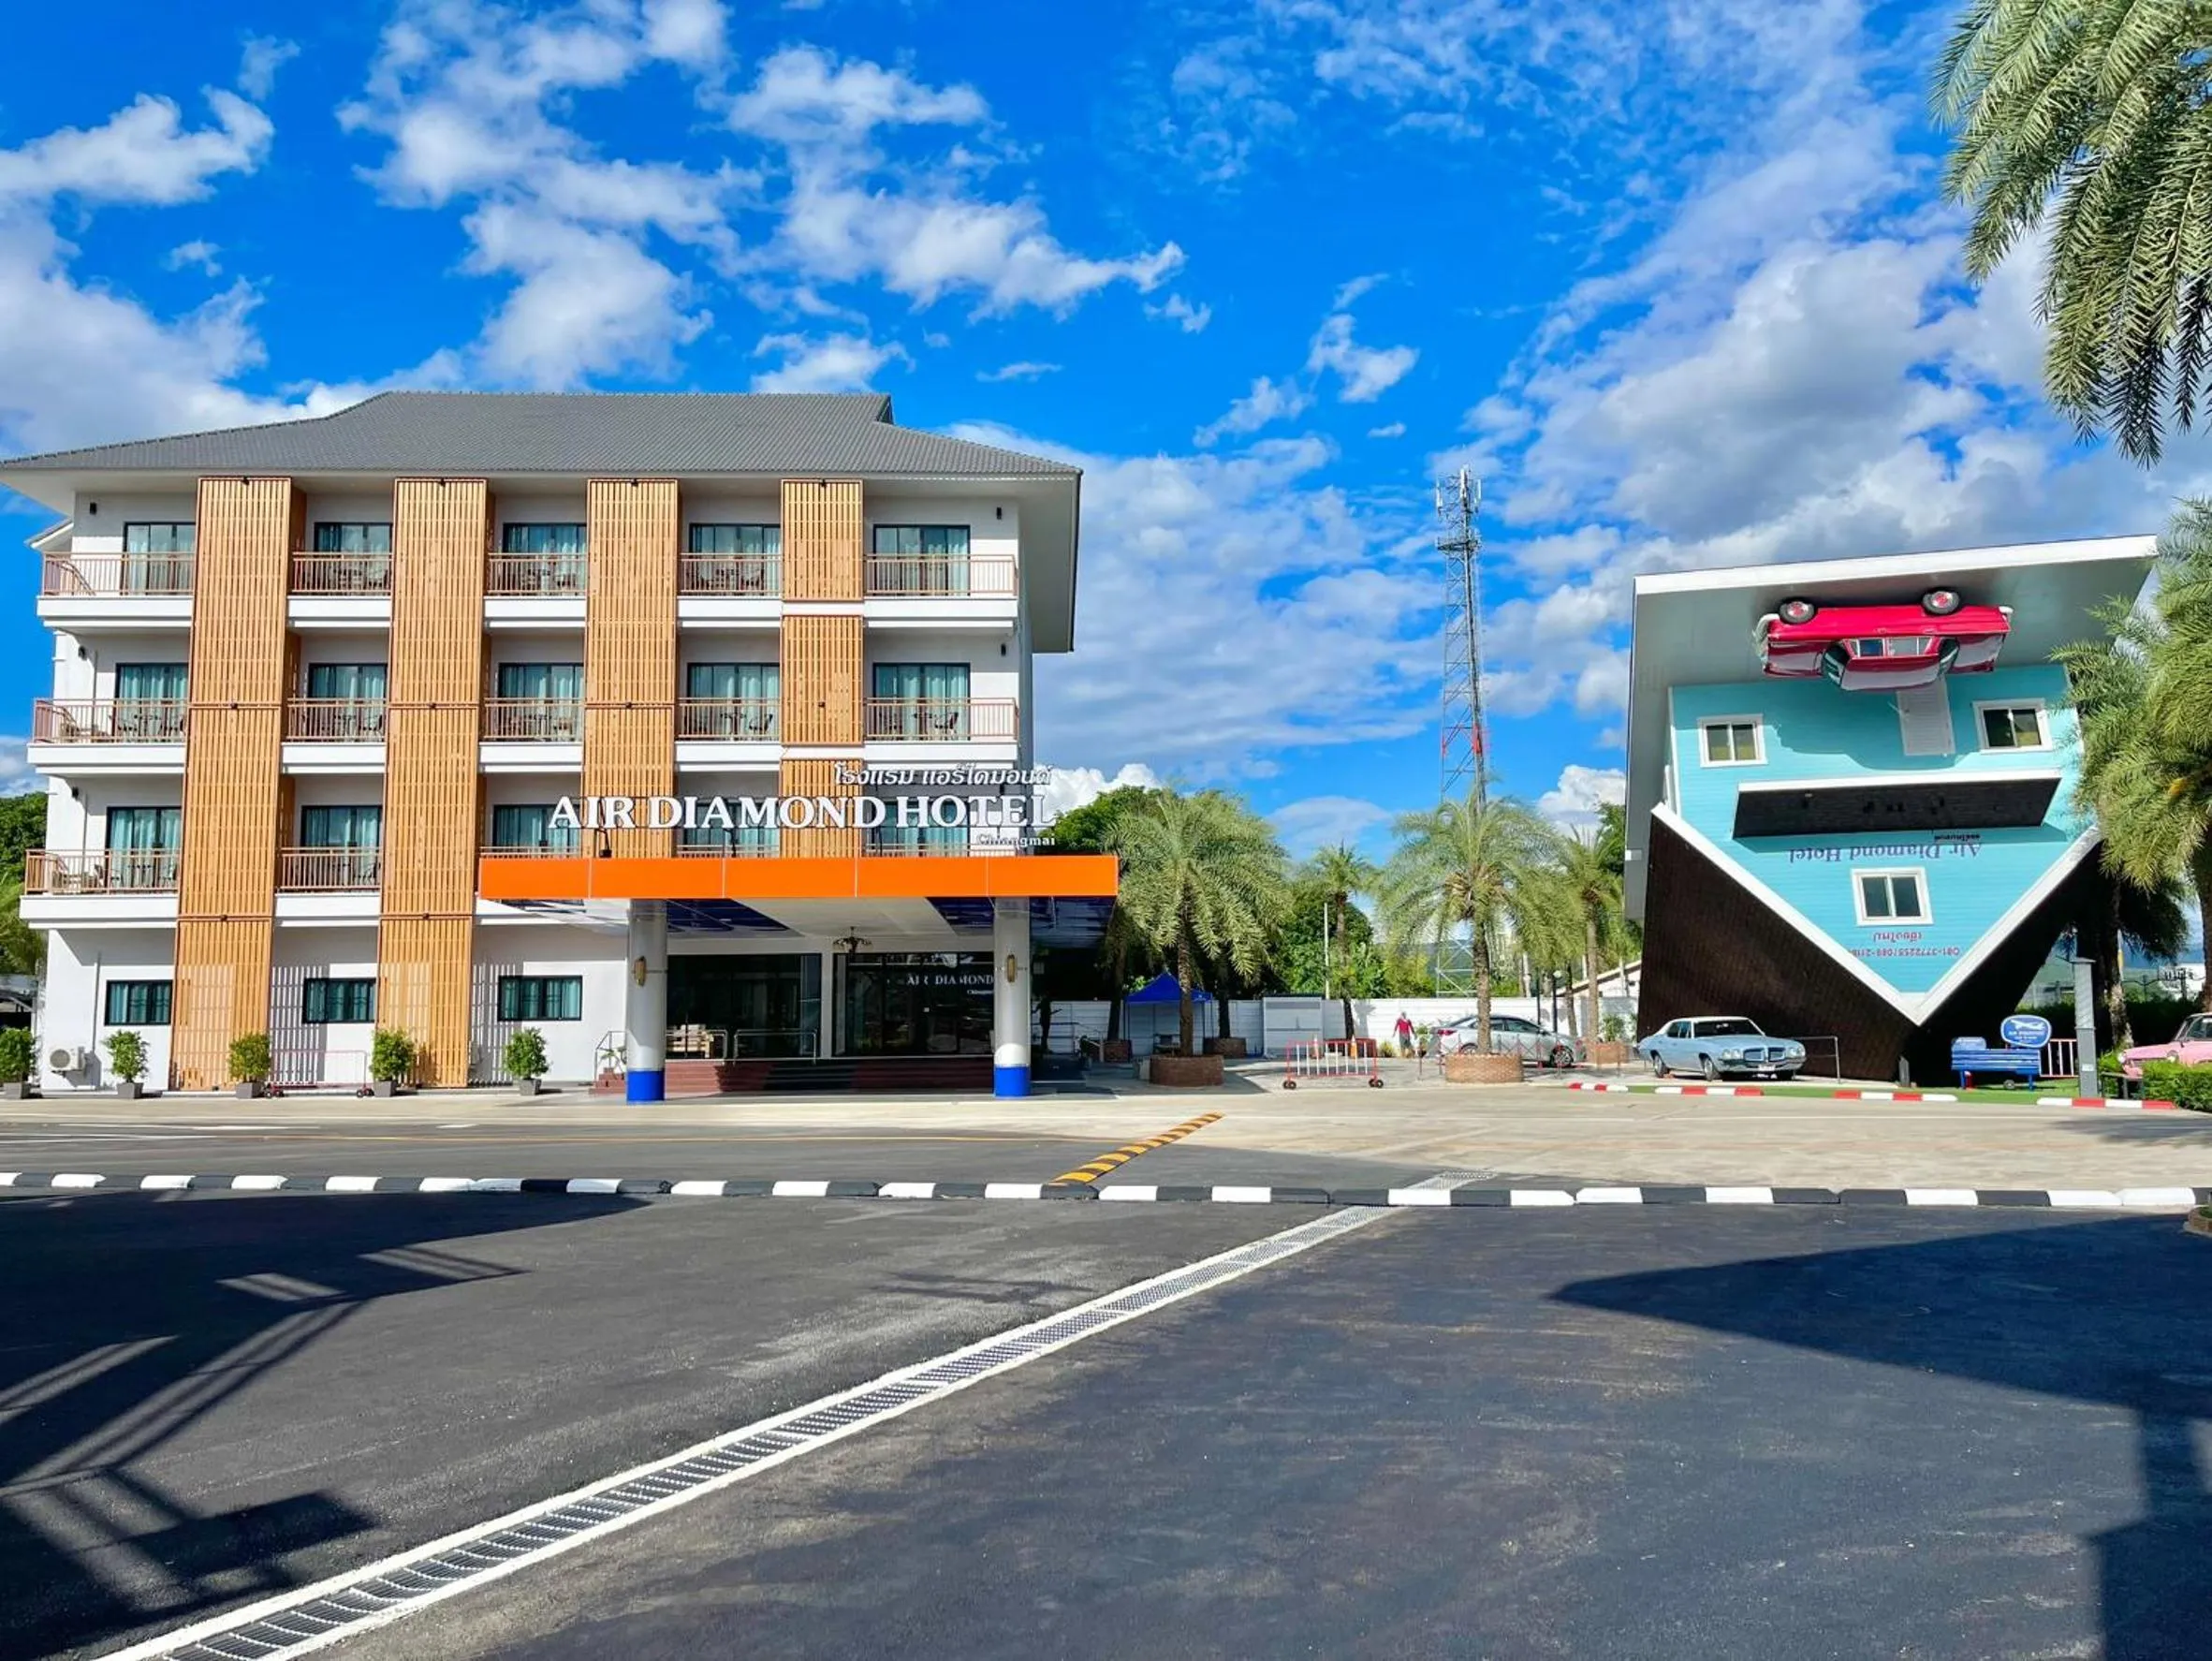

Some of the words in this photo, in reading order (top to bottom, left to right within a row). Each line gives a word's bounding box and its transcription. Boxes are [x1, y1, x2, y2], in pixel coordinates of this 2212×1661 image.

[835, 763, 915, 786] โรงแรม
[548, 796, 637, 829] AIR
[647, 795, 886, 829] DIAMOND
[895, 794, 1057, 829] HOTEL
[1789, 847, 1842, 863] Hotel
[1849, 845, 1941, 860] Diamond
[1949, 843, 1983, 858] Air
